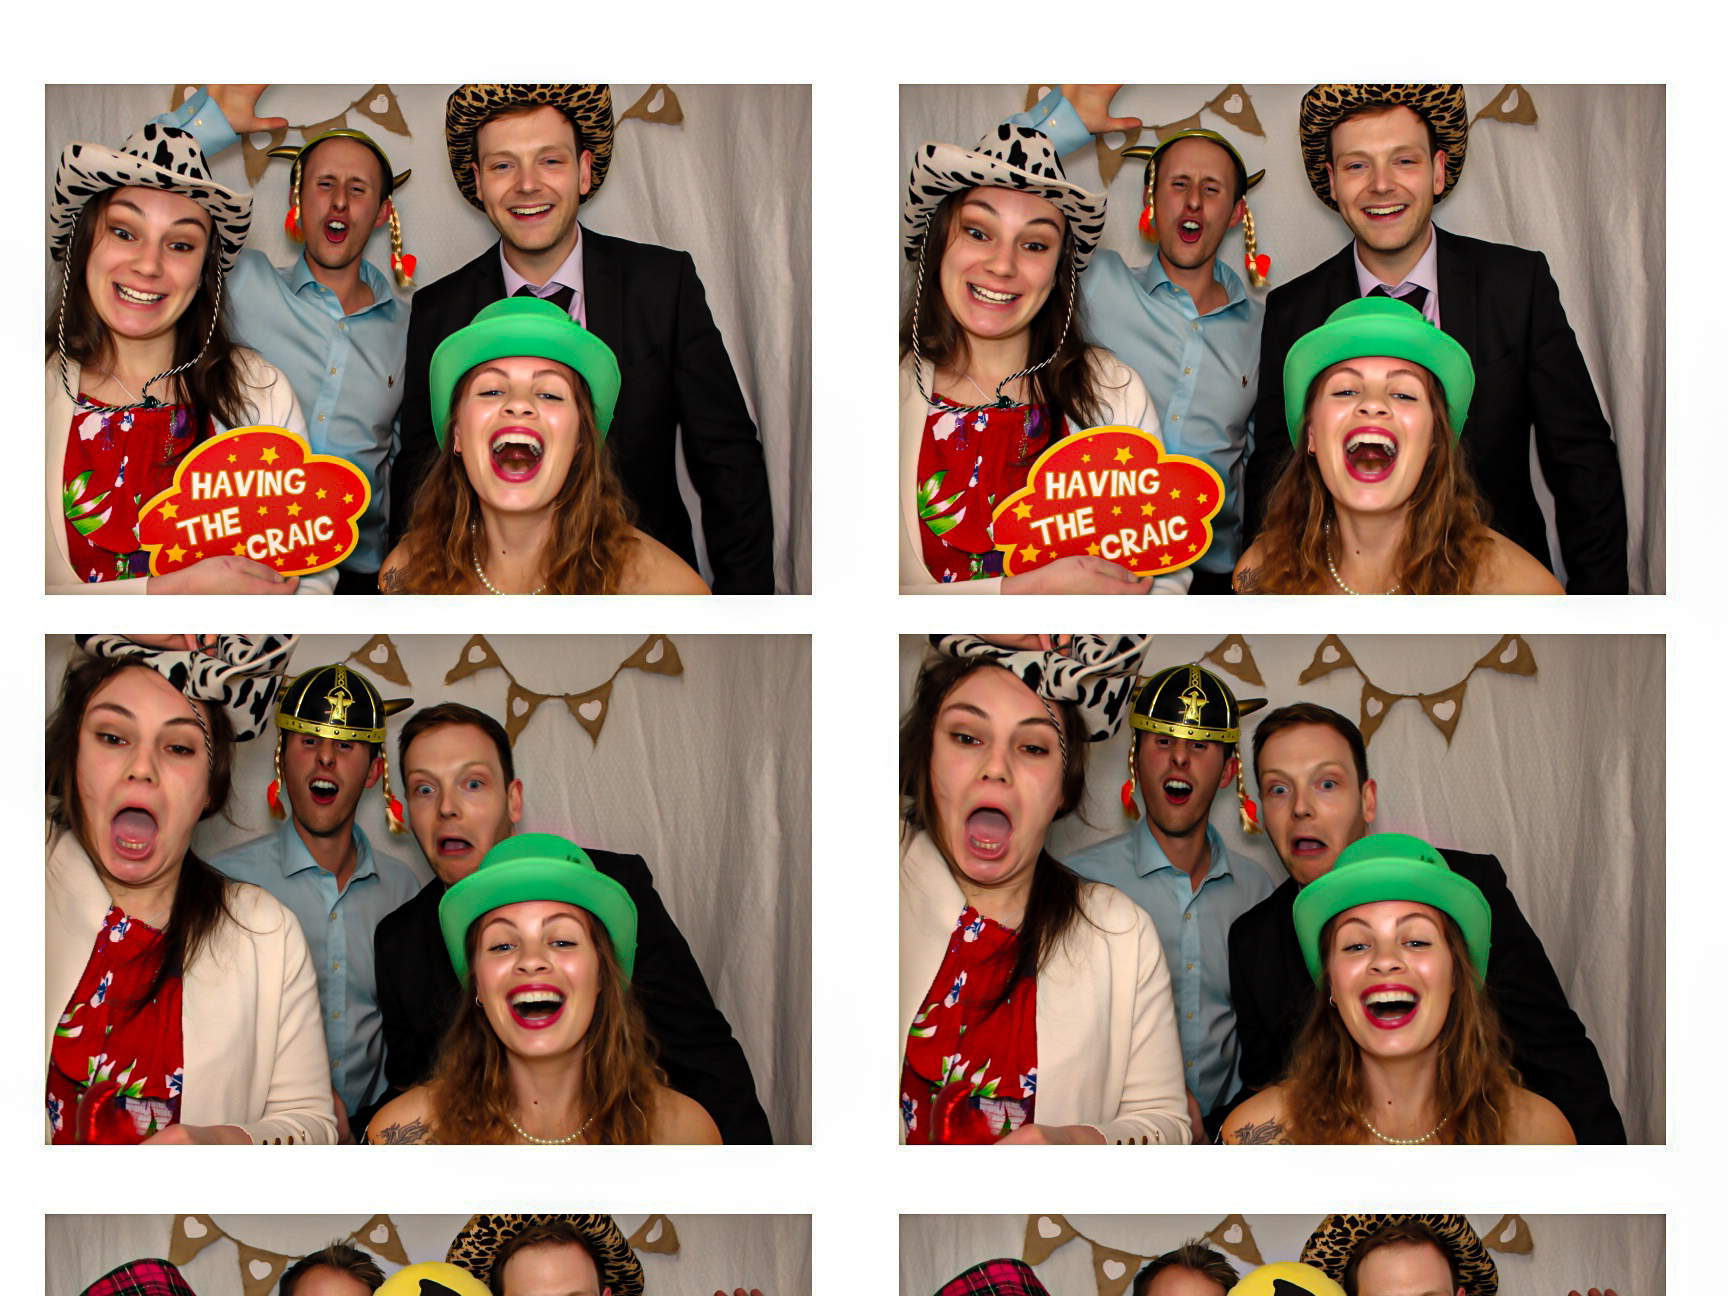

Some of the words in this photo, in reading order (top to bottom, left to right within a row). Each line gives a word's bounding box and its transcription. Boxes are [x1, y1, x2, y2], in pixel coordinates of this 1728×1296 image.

[191, 468, 307, 500] HAVING
[1045, 468, 1161, 500] HAVING
[176, 506, 242, 546] THE
[246, 515, 335, 561] CRAIC
[1030, 506, 1096, 546] THE
[1100, 515, 1189, 561] CRAIC
